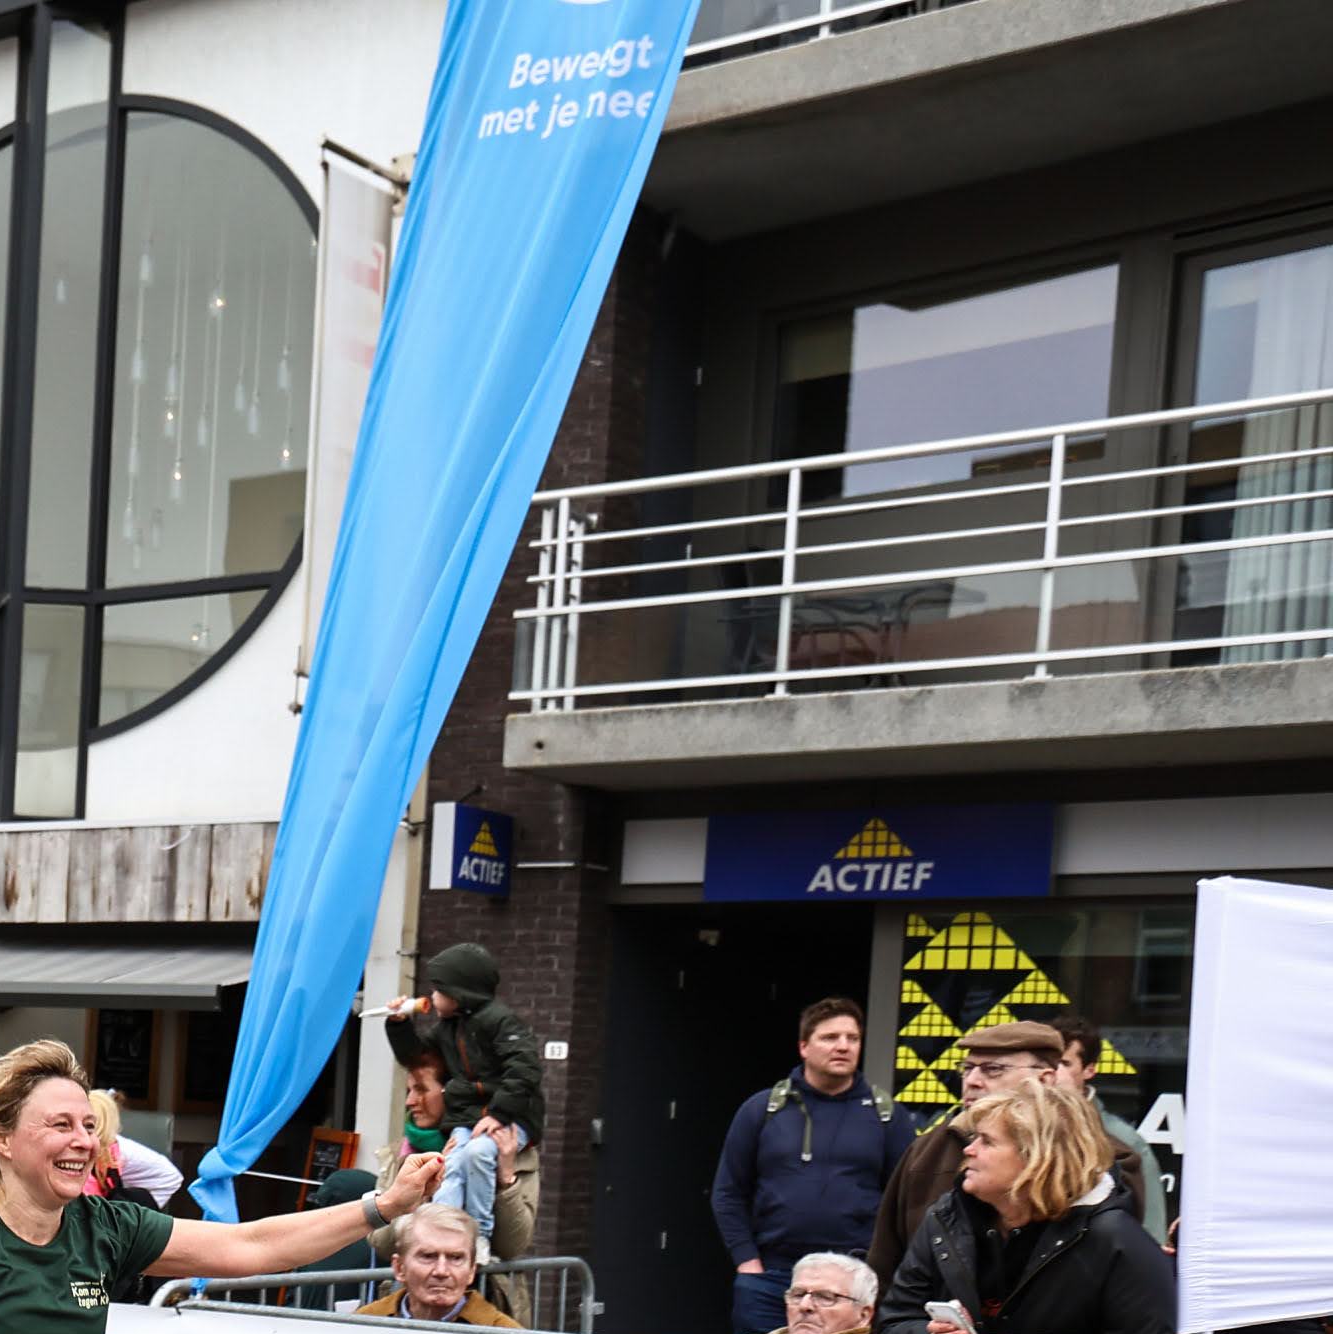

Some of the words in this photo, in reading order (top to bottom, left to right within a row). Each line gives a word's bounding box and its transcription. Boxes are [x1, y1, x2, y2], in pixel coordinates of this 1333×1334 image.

[508, 33, 654, 90] Bewegt
[478, 100, 540, 139] met
[541, 93, 580, 139] je
[458, 855, 505, 886] ACTIEF
[806, 861, 936, 893] ACTIEF
[71, 1286, 90, 1298] Kom
[90, 1287, 101, 1298] op
